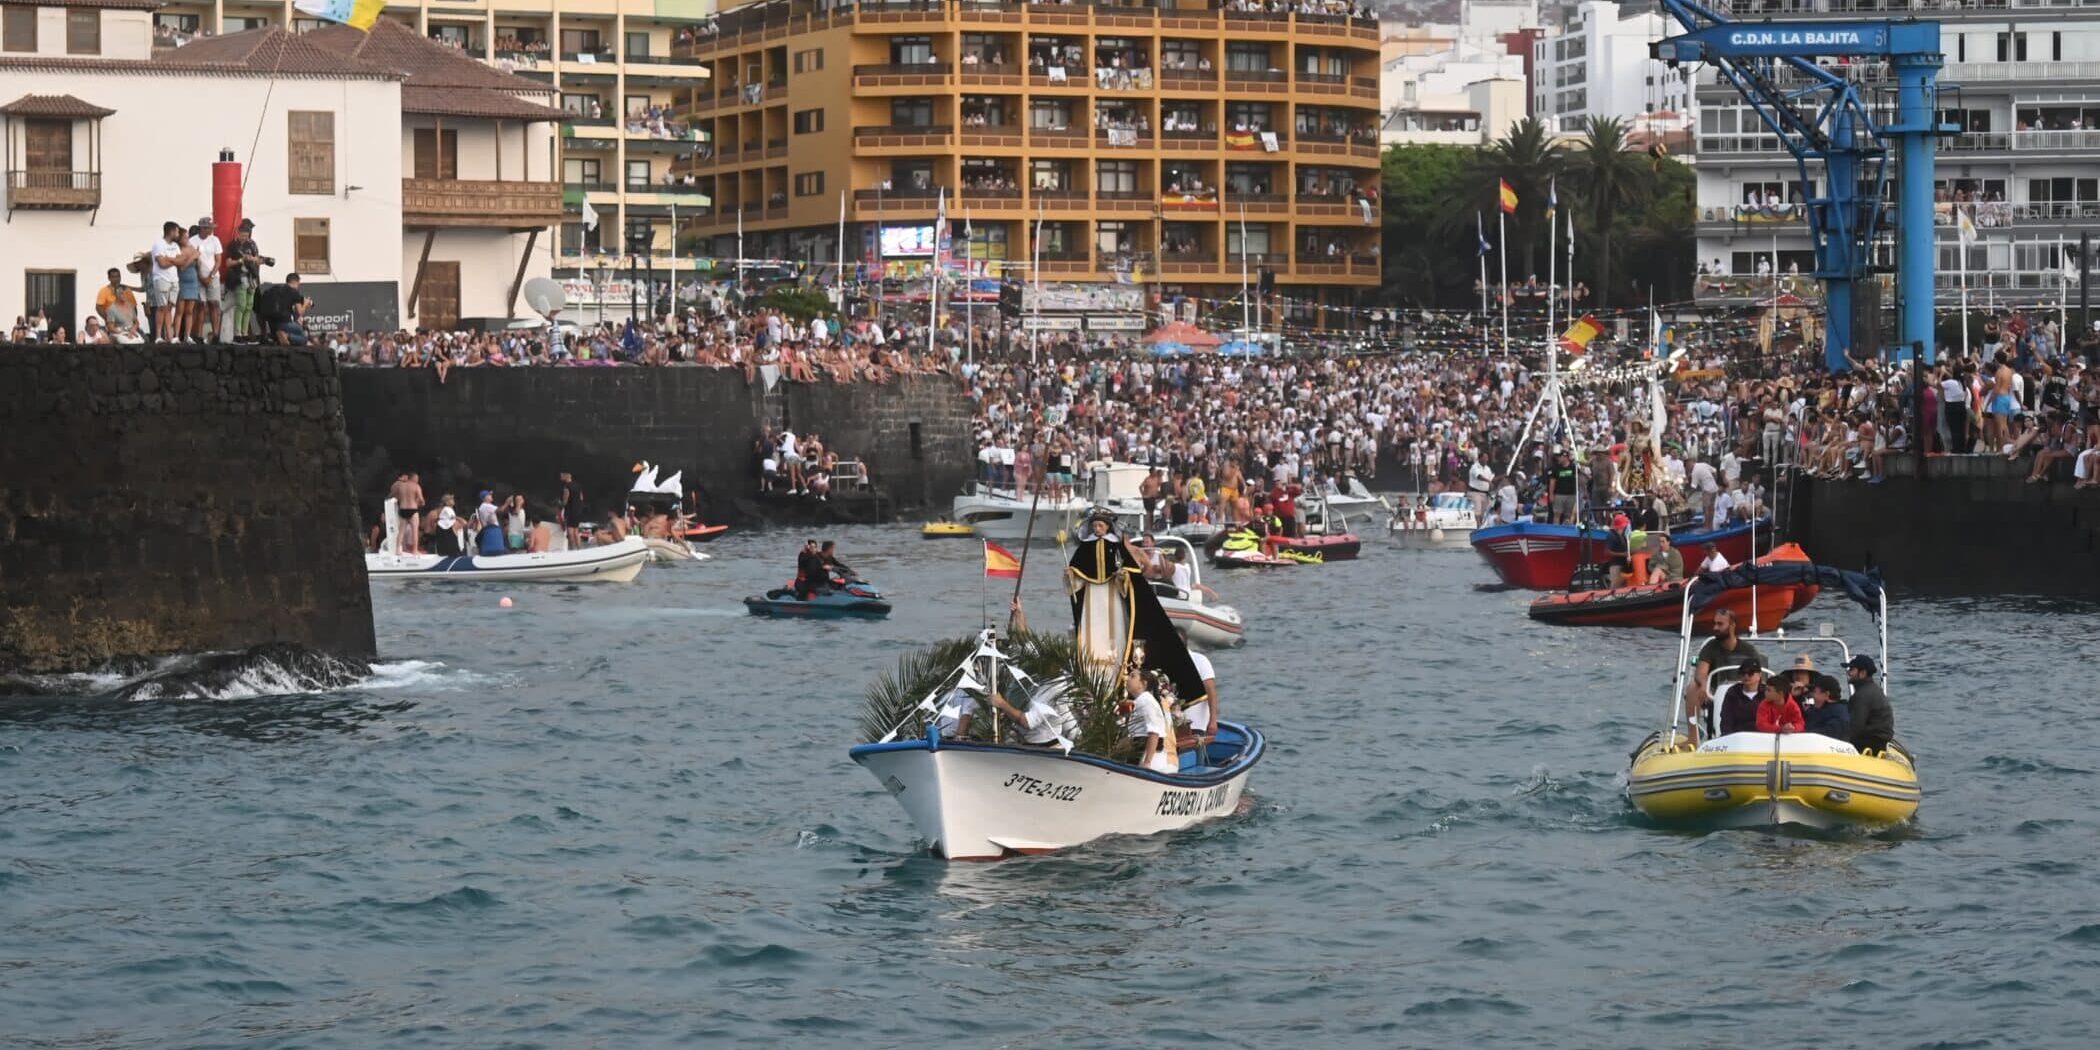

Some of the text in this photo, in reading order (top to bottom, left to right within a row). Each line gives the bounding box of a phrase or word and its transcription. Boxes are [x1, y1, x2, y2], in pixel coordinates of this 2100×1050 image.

[1731, 32, 1860, 45] C.D.N. LA BAJITA
